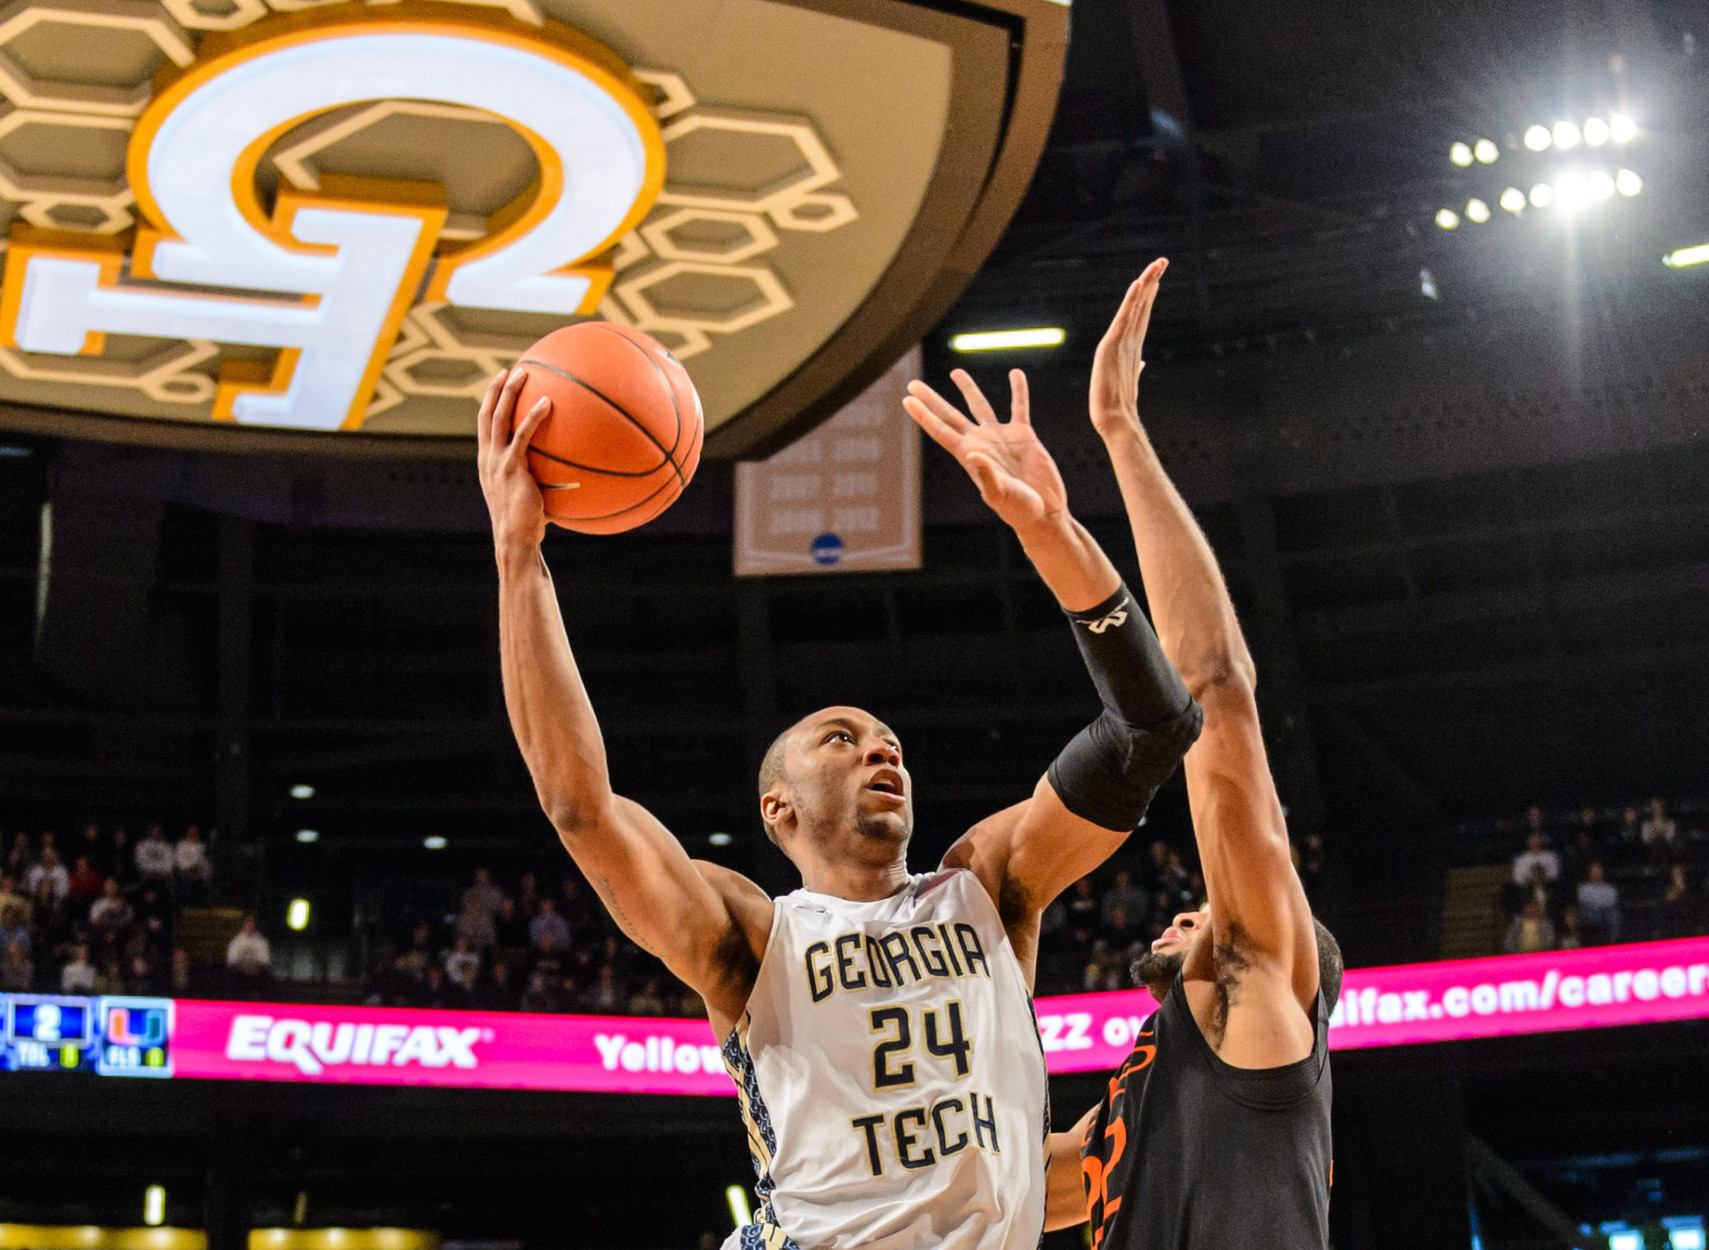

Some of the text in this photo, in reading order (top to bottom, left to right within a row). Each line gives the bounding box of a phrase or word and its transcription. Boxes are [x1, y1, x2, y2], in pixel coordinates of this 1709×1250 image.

[804, 922, 992, 1004] GEORGIA
[34, 1003, 61, 1042] 2
[226, 1014, 482, 1075] EQUIFAX
[868, 1001, 974, 1093] 24
[851, 1091, 1002, 1177] TECH
